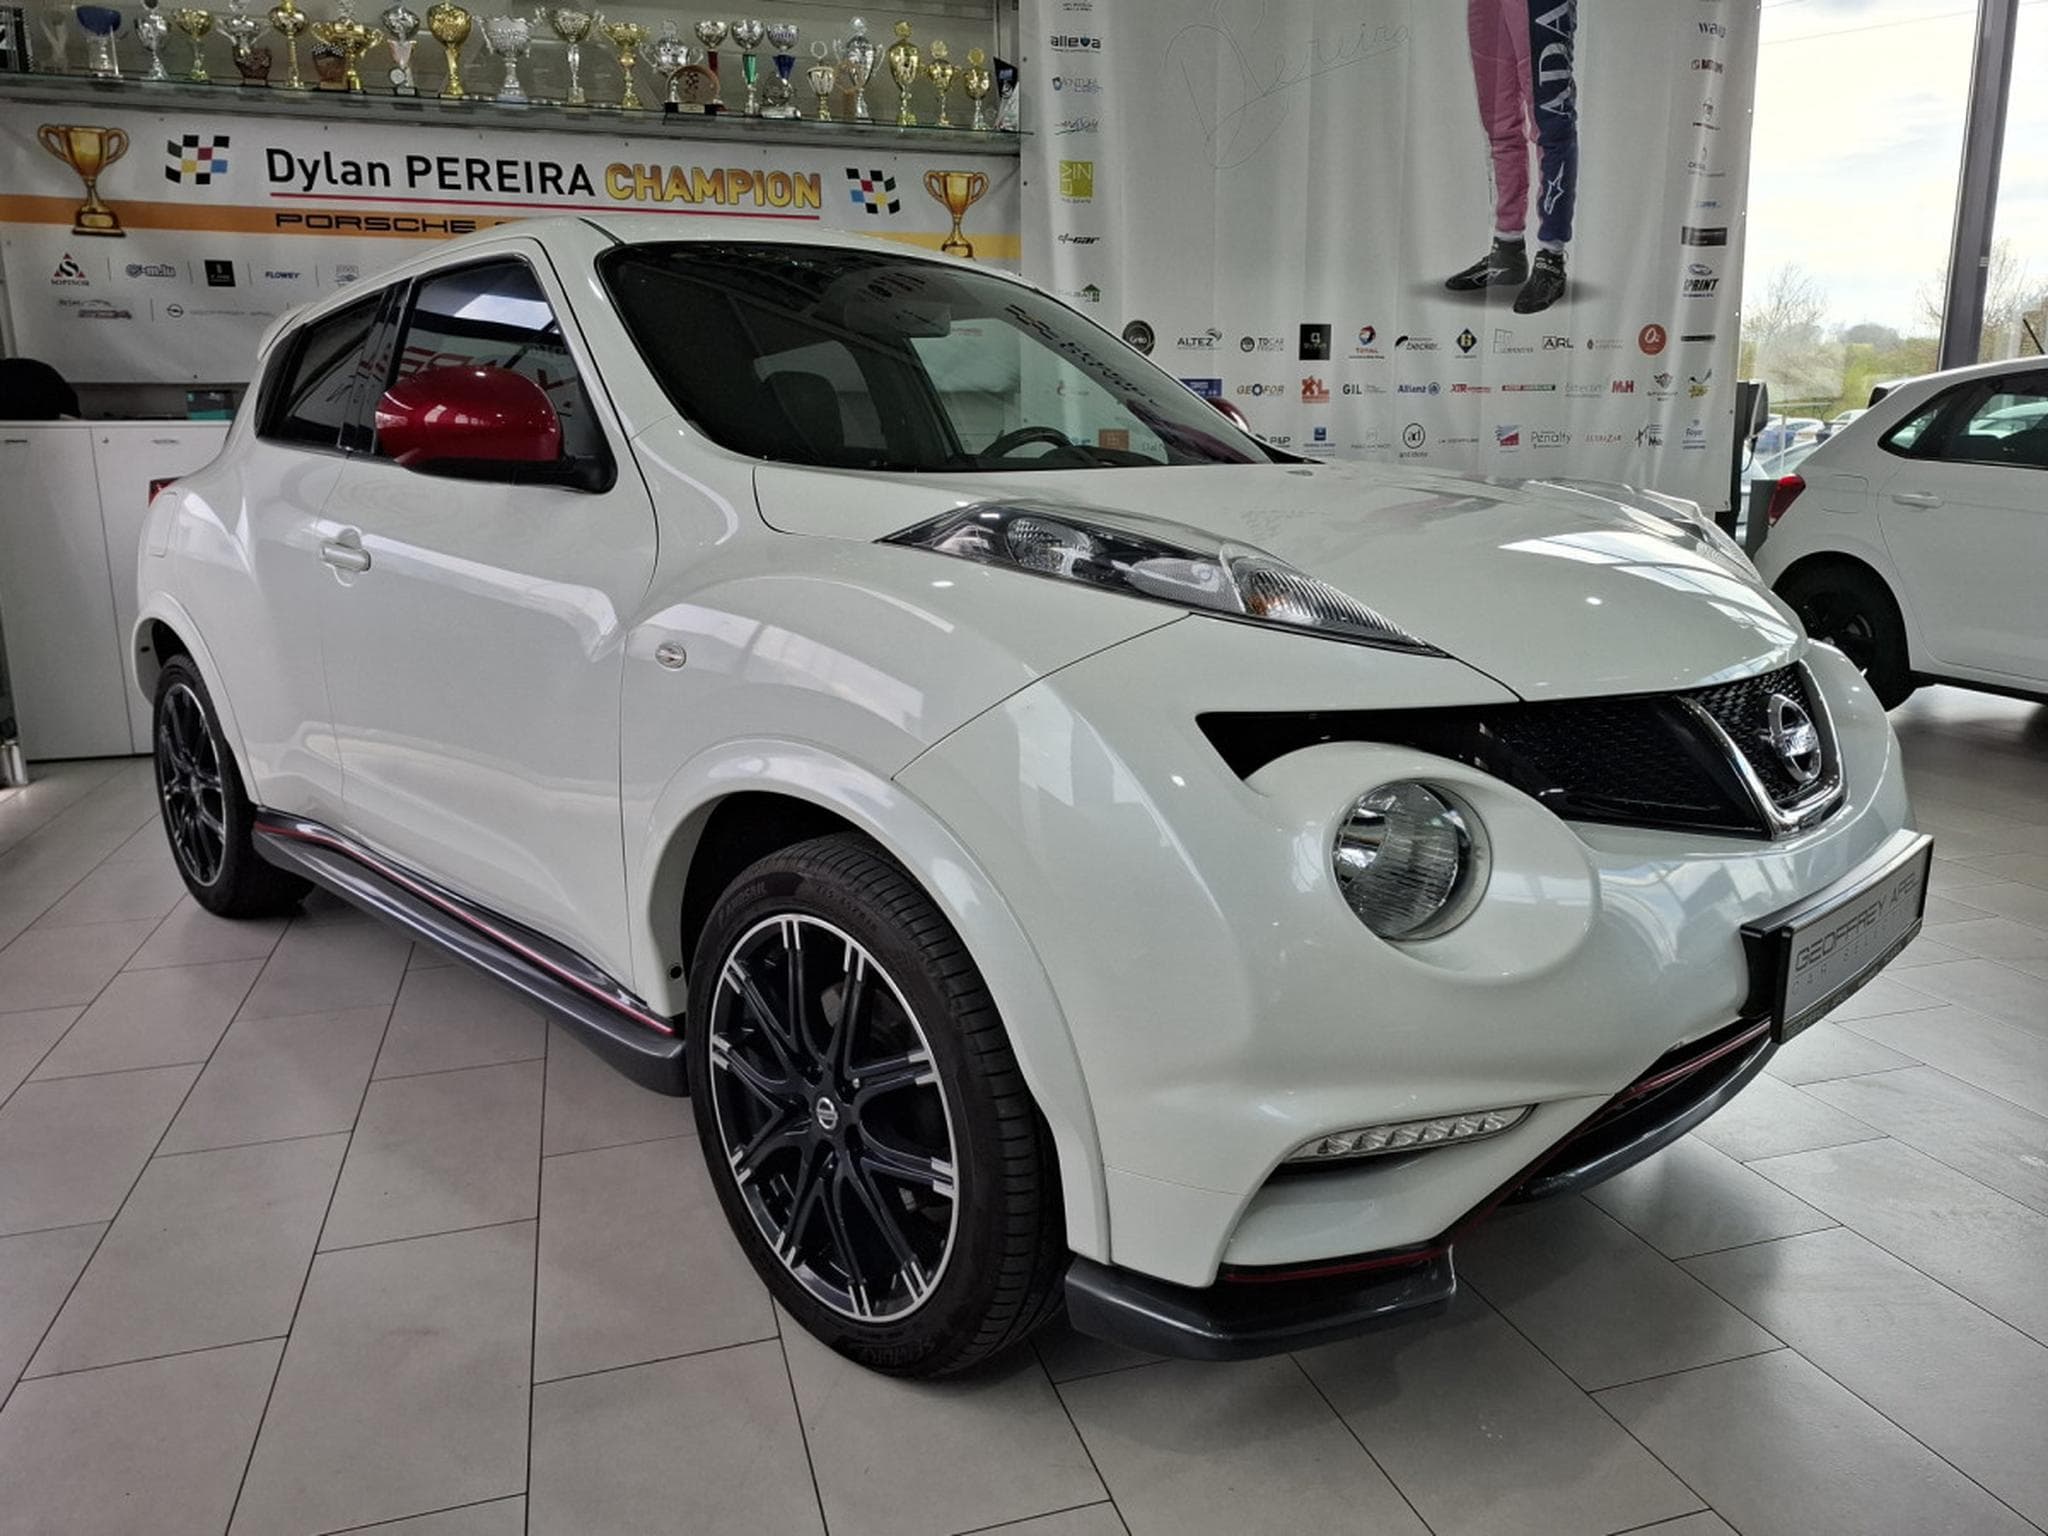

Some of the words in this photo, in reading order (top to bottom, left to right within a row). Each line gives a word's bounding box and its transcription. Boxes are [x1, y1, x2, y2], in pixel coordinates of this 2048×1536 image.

[266, 148, 391, 191] Dylan
[407, 156, 595, 197] PEREIRA
[604, 162, 823, 209] CHAMPION
[276, 213, 477, 234] PORSCHE
[265, 271, 300, 279] FLOWEY
[1177, 337, 1213, 347] ALTEZ
[1342, 383, 1362, 395] GIL
[1397, 384, 1427, 394] Allianz
[1796, 894, 1888, 971] GEOFFREY
